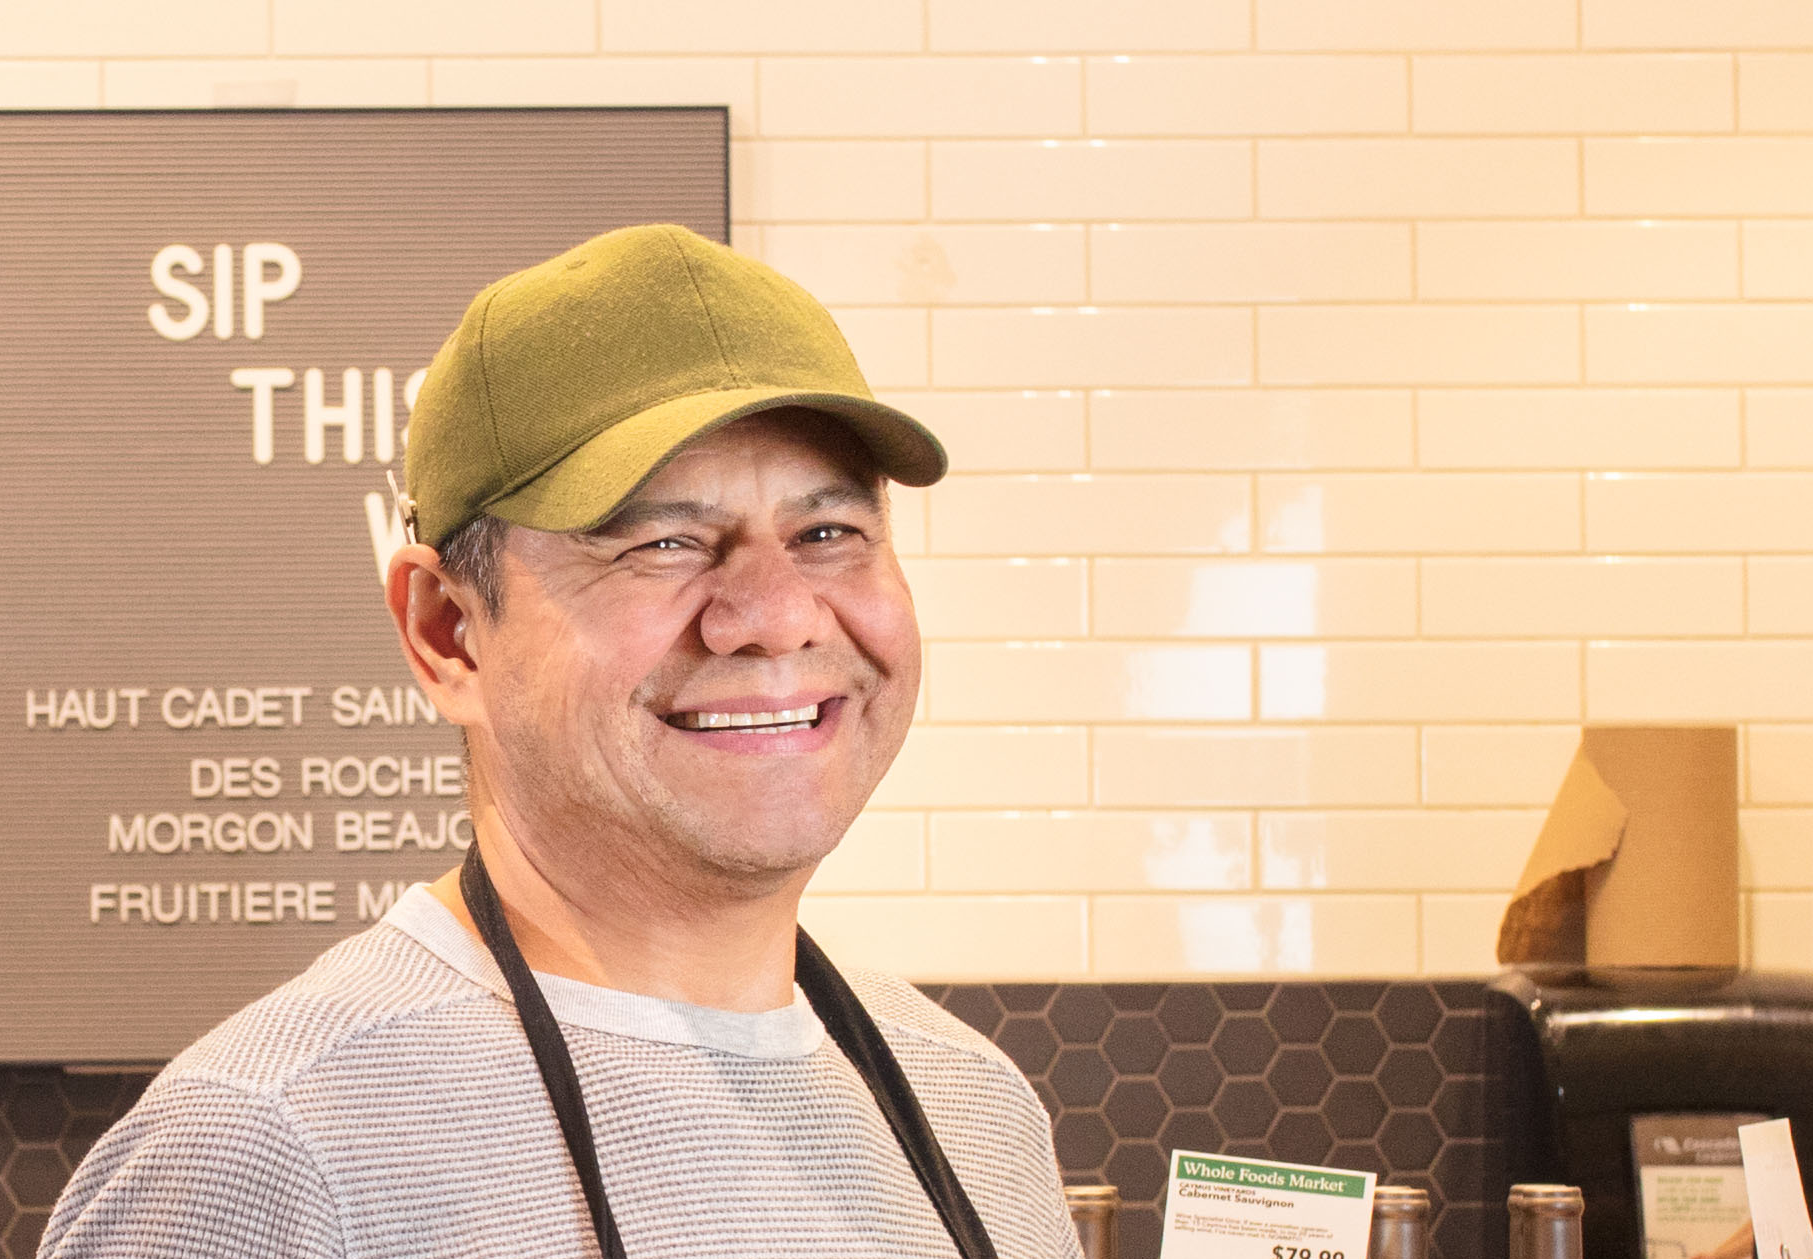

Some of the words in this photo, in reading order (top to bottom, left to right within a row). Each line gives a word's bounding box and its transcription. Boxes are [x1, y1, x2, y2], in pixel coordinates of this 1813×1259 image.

[148, 242, 302, 340] SIP
[26, 689, 148, 728] HAUT
[161, 687, 312, 728] CADET
[331, 686, 440, 725] SAIN
[191, 758, 281, 797] DES
[302, 757, 464, 796] ROCHE
[109, 813, 313, 853] MORGON
[336, 811, 476, 851] BEAJO
[90, 882, 336, 923] FRUITIERE
[1183, 1160, 1234, 1180] Whole
[1239, 1168, 1285, 1186] Foods
[1289, 1174, 1345, 1192] Market
[1179, 1189, 1232, 1203] Cabernet
[1235, 1193, 1295, 1210] Sauvignon
